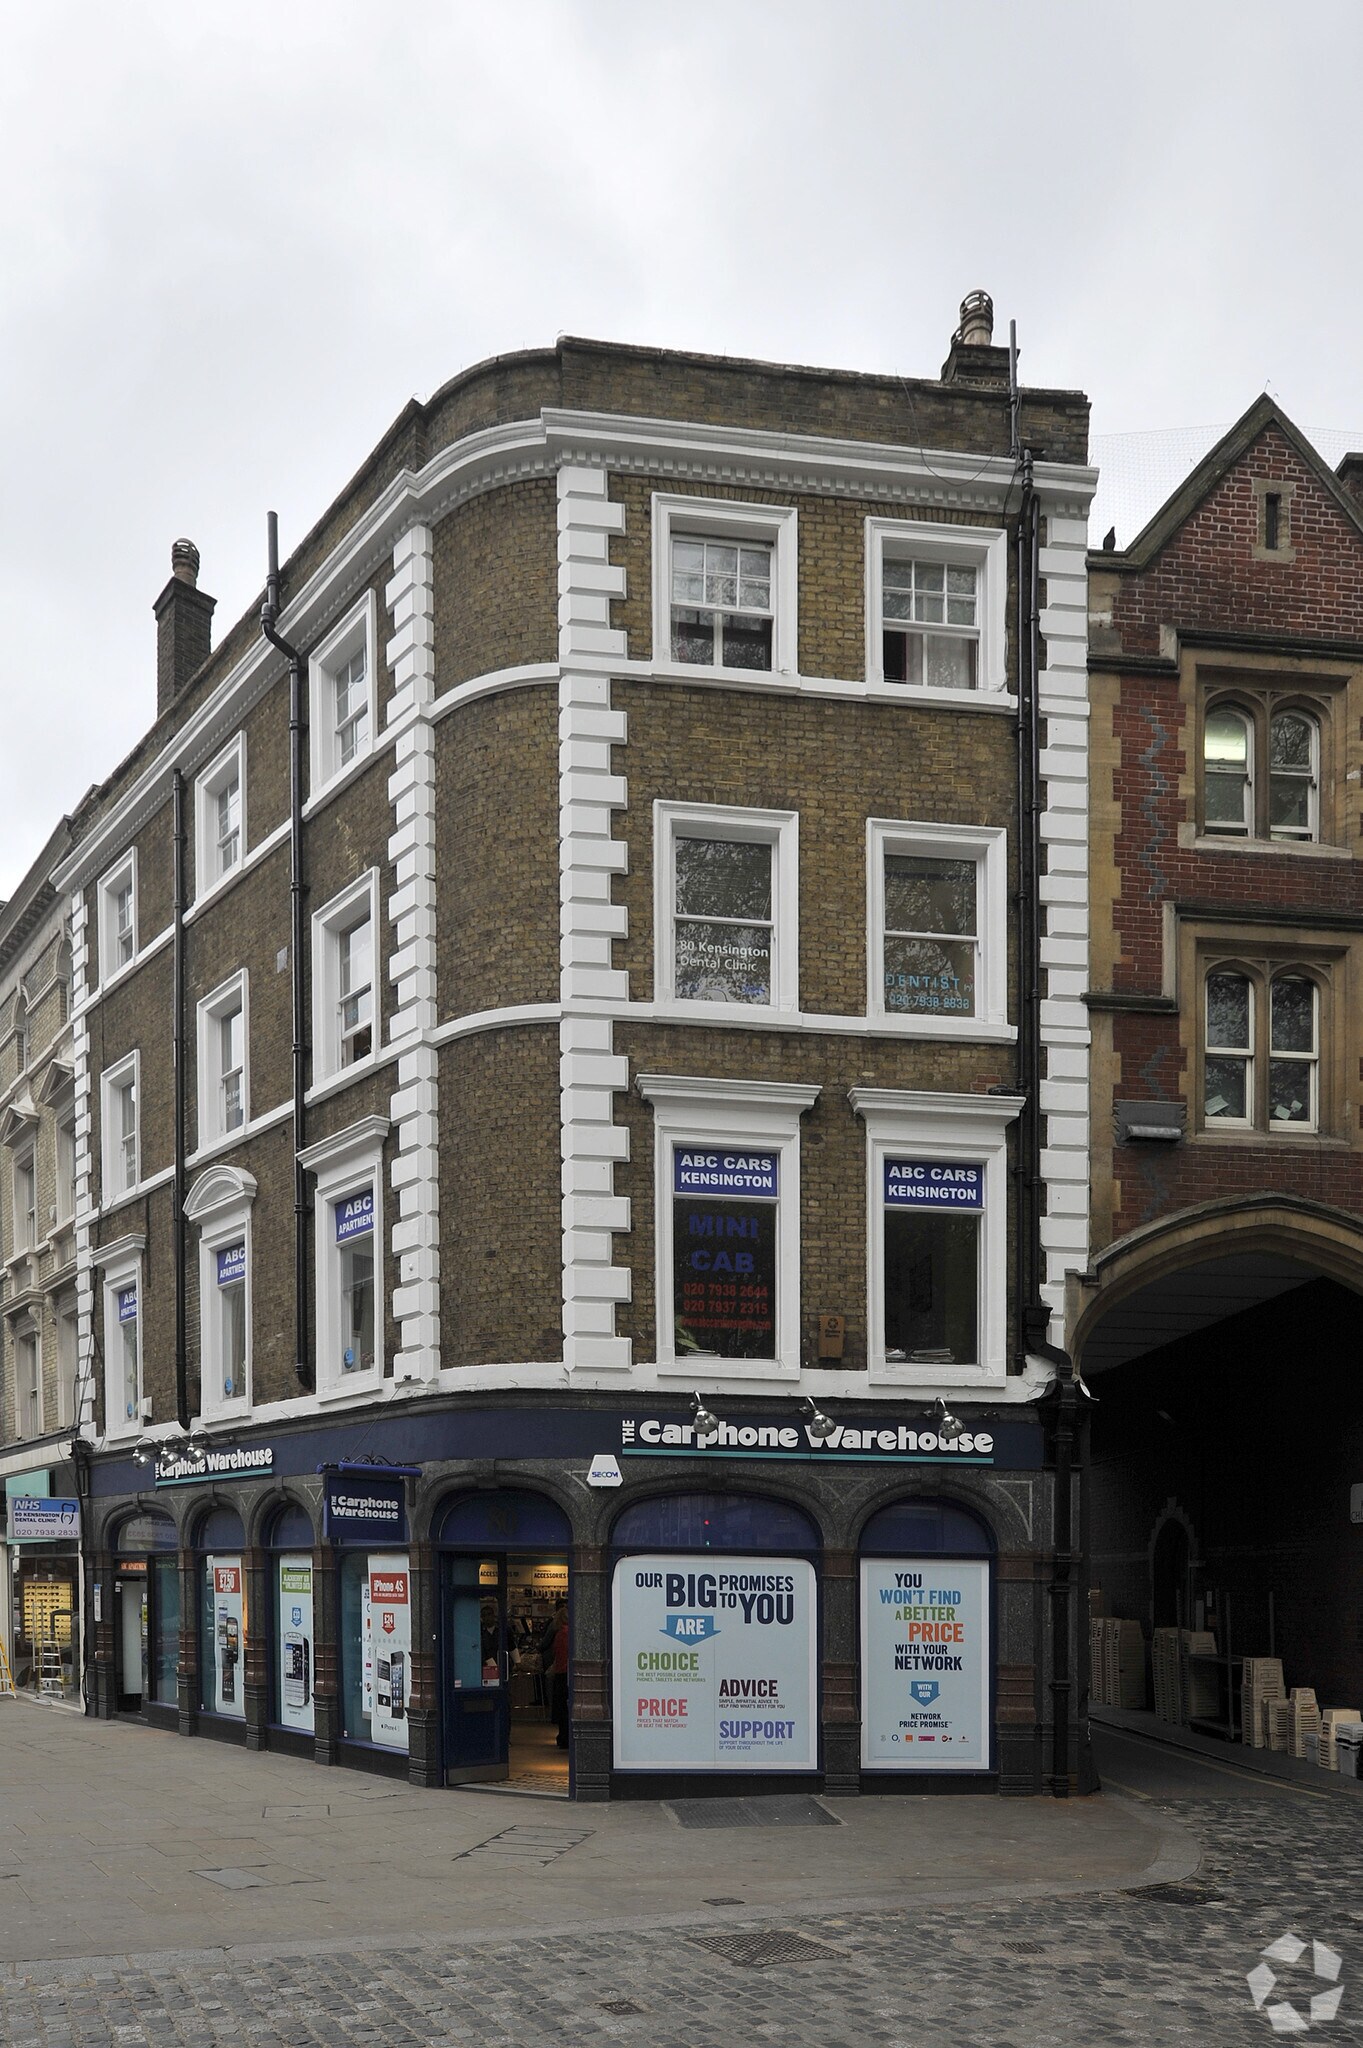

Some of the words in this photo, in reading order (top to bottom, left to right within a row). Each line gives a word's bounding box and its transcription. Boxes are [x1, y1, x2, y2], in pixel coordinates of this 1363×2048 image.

[680, 940, 695, 951] 80
[699, 941, 768, 958] Kensington
[680, 955, 720, 968] Dental
[724, 959, 757, 972] Clinic
[885, 973, 960, 990] DENTIST
[680, 1154, 718, 1168] ABC
[723, 1157, 772, 1171] CARS
[680, 1171, 772, 1188] KENSINGTON
[889, 1166, 925, 1179] ABC
[930, 1168, 977, 1183] CARS
[888, 1184, 977, 1200] KENSINGTON
[344, 1196, 372, 1218] ABC
[689, 1214, 759, 1239] MINI
[225, 1247, 245, 1265] ABC
[690, 1249, 755, 1273] CAB
[683, 1282, 705, 1295] 020
[709, 1283, 736, 1297] 7938
[709, 1301, 736, 1314] 7937
[622, 1419, 635, 1445] THE
[639, 1420, 799, 1449] Carphone
[804, 1425, 994, 1453] Warehouse
[206, 1447, 273, 1472] Warehouse
[15, 1500, 40, 1510] NHS
[338, 1495, 399, 1510] Carphone
[331, 1506, 399, 1519] Warehouse
[374, 1579, 394, 1592] iPhone
[395, 1580, 404, 1593] 4S
[895, 1573, 922, 1588] YOU
[635, 1572, 663, 1588] OUR
[666, 1573, 717, 1608] BIG
[719, 1575, 794, 1592] PROMISES
[880, 1589, 925, 1605] WON'T
[929, 1590, 961, 1605] FIND
[719, 1593, 737, 1609] TO
[738, 1593, 794, 1625] YOU
[895, 1610, 901, 1620] A
[903, 1606, 956, 1621] BETTER
[675, 1618, 705, 1635] ARE
[908, 1622, 964, 1643] PRICE
[895, 1644, 920, 1655] WITH
[922, 1644, 948, 1655] YOUR
[637, 1652, 699, 1671] CHOICE
[894, 1655, 963, 1671] NETWORK
[719, 1679, 778, 1697] ADVICE
[917, 1683, 932, 1691] WITH
[637, 1698, 688, 1717] PRICE
[719, 1720, 795, 1739] SUPPORT
